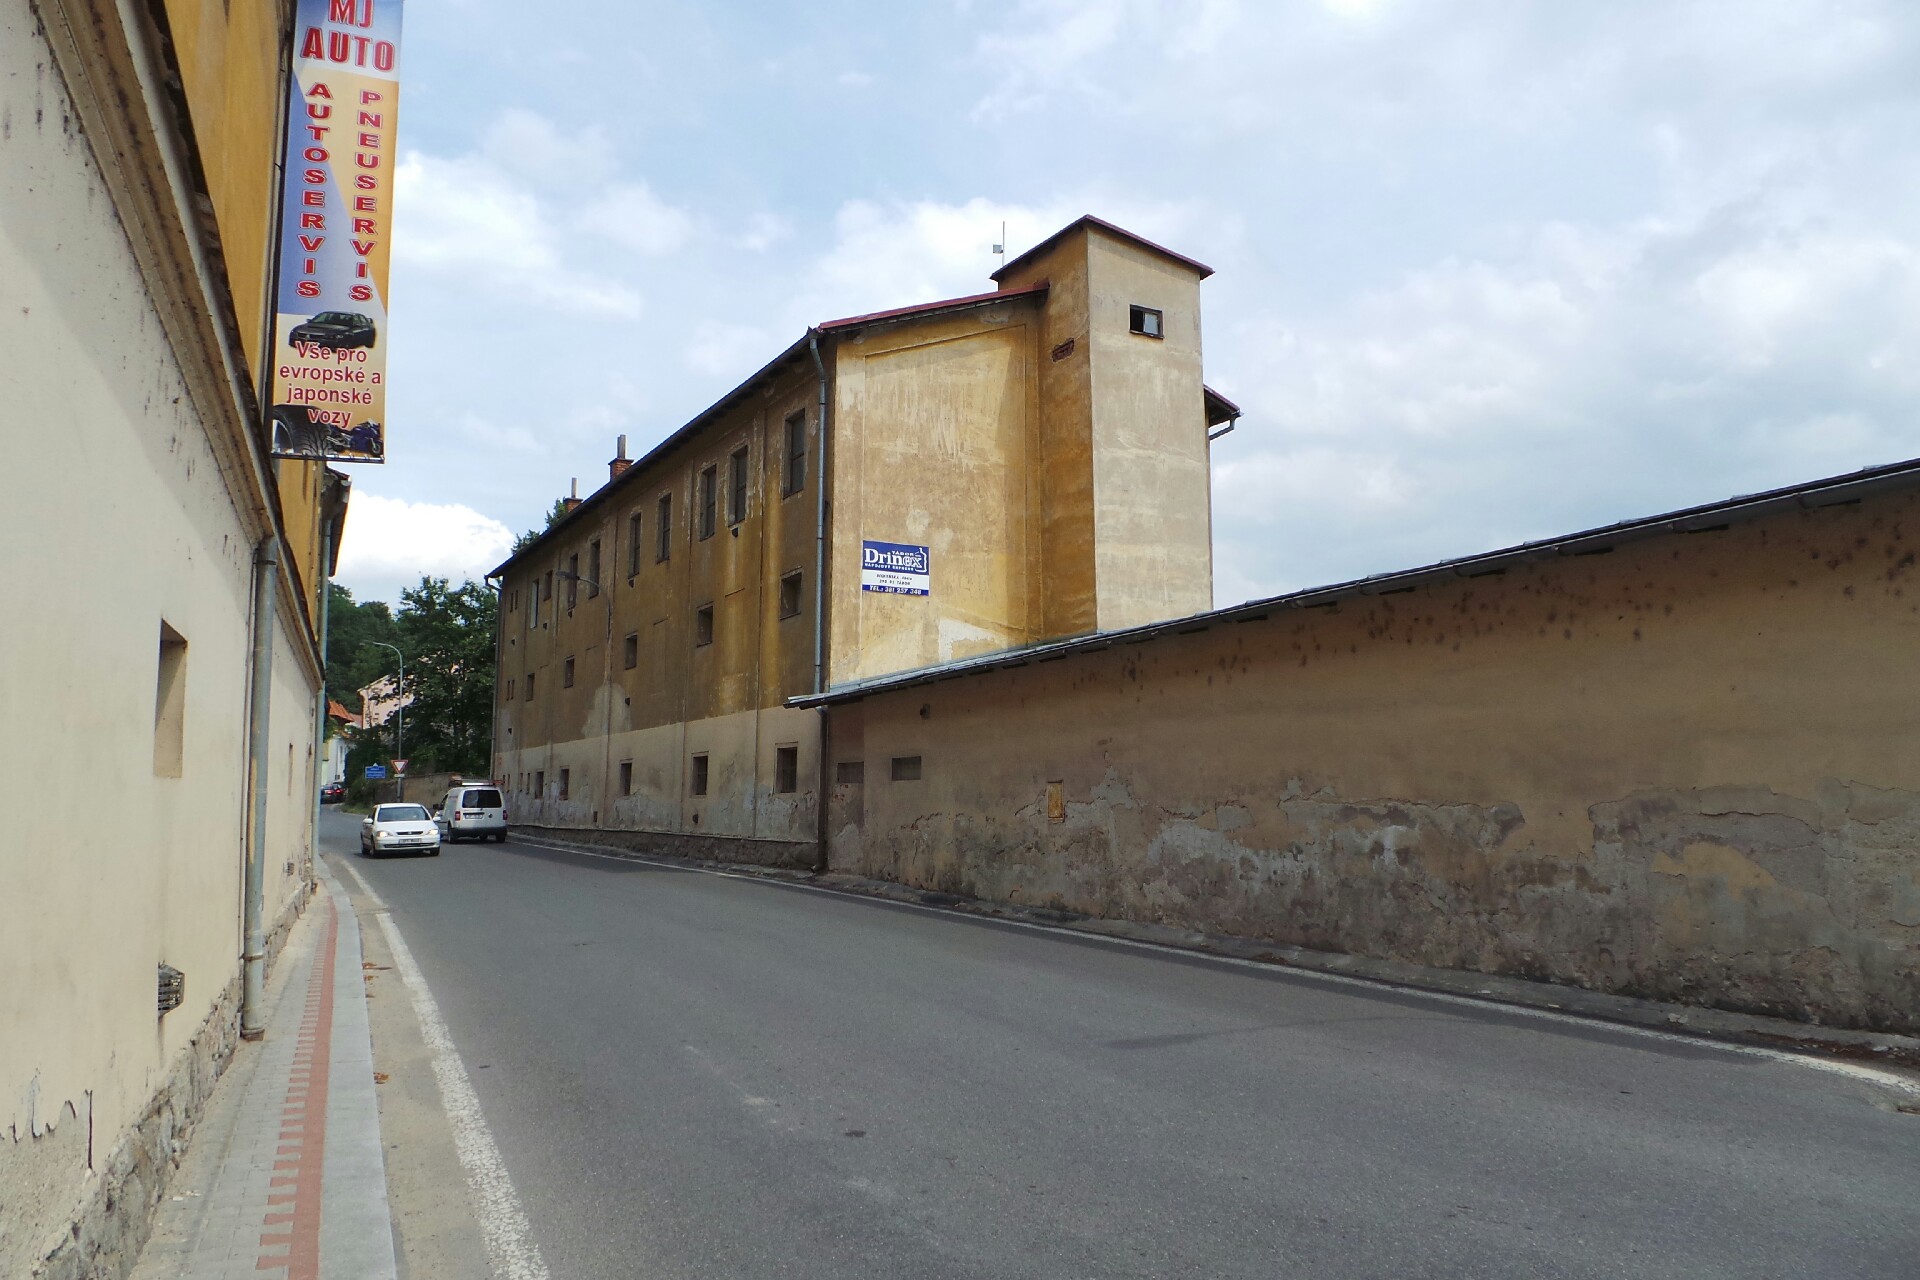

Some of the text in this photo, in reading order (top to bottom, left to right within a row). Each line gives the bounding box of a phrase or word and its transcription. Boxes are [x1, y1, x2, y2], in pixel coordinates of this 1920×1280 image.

[328, 0, 374, 28] MJ
[300, 26, 395, 73] AUTO
[296, 82, 334, 298] AUTOSERVIS
[349, 89, 383, 302] PNEUSERVIS
[295, 340, 368, 365] Vše pro
[279, 365, 381, 385] evropské a
[286, 383, 373, 405] japonské
[307, 408, 352, 429] vozy
[864, 548, 923, 568] Drinex
